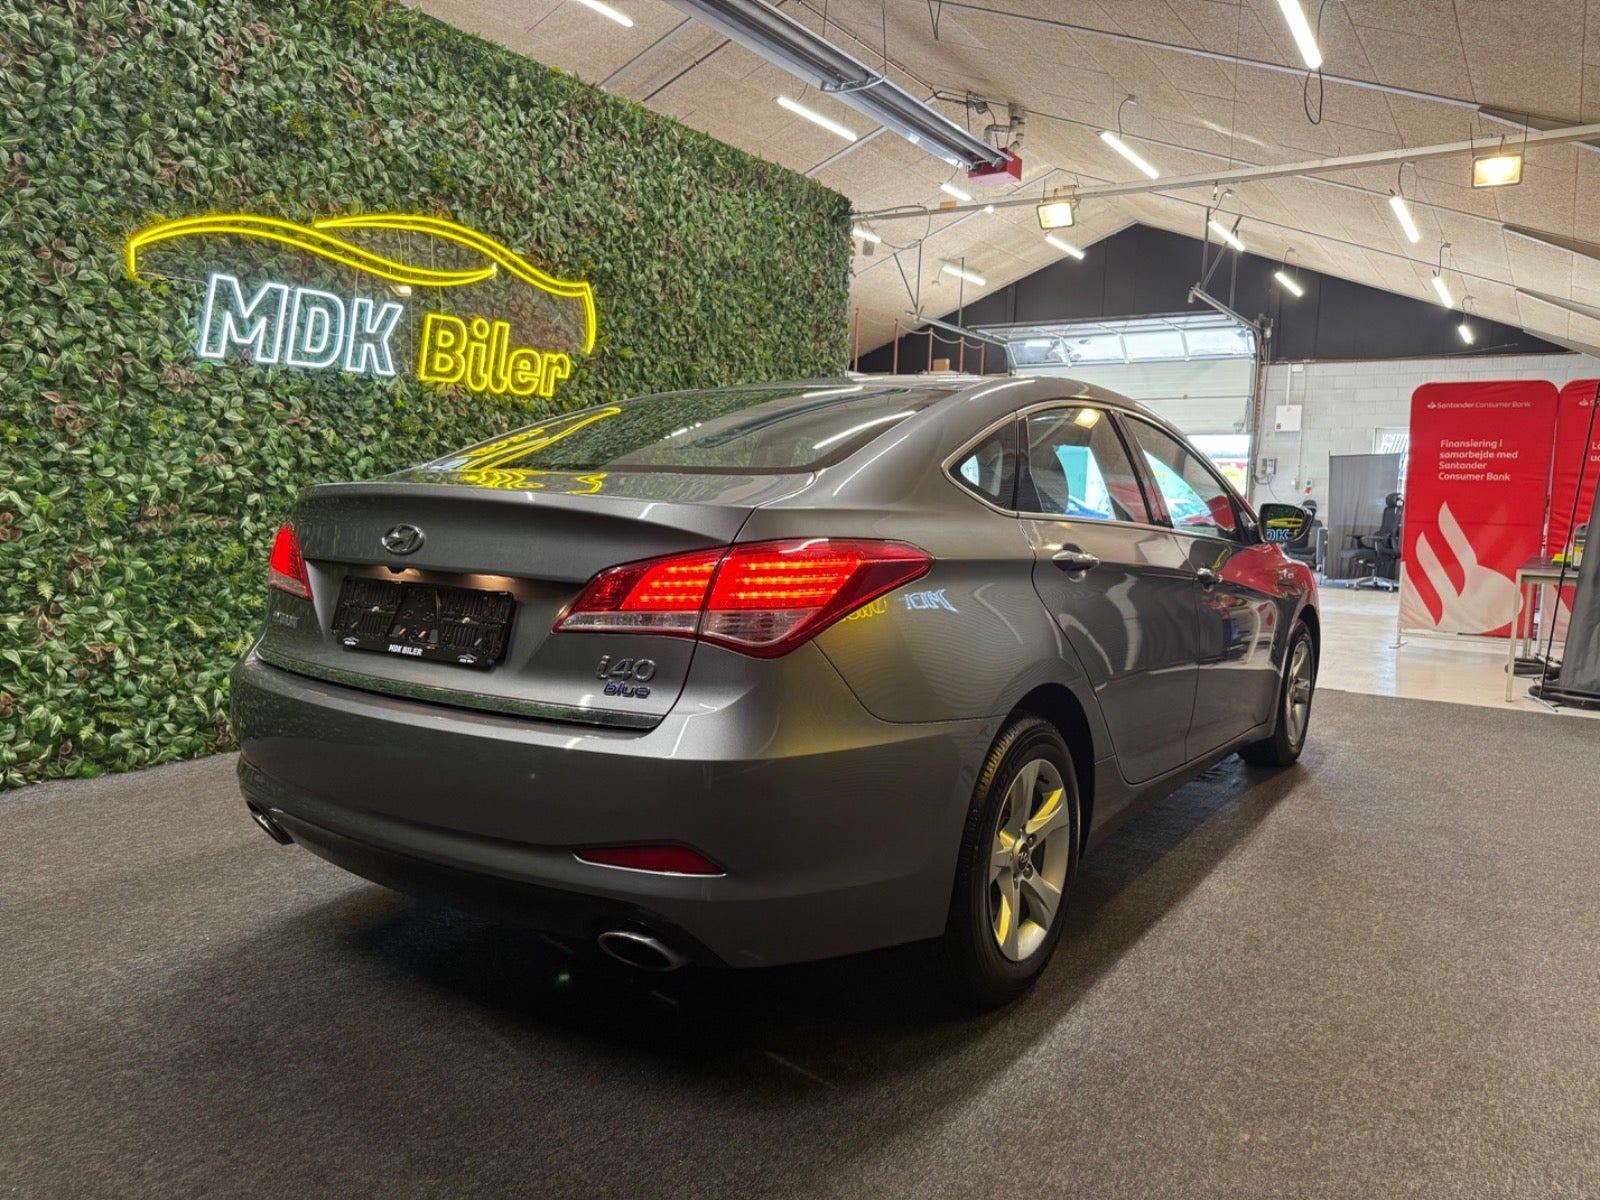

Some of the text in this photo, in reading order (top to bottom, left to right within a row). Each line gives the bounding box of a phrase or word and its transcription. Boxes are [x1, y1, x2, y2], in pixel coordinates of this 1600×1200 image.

[199, 273, 571, 398] MDK Biler
[1440, 439, 1498, 449] Finansiering
[1439, 451, 1519, 460] samarbejde med
[1439, 461, 1487, 470] Santander
[1438, 472, 1511, 481] Consumer Bank
[598, 655, 656, 681] i40
[603, 679, 650, 699] blue
